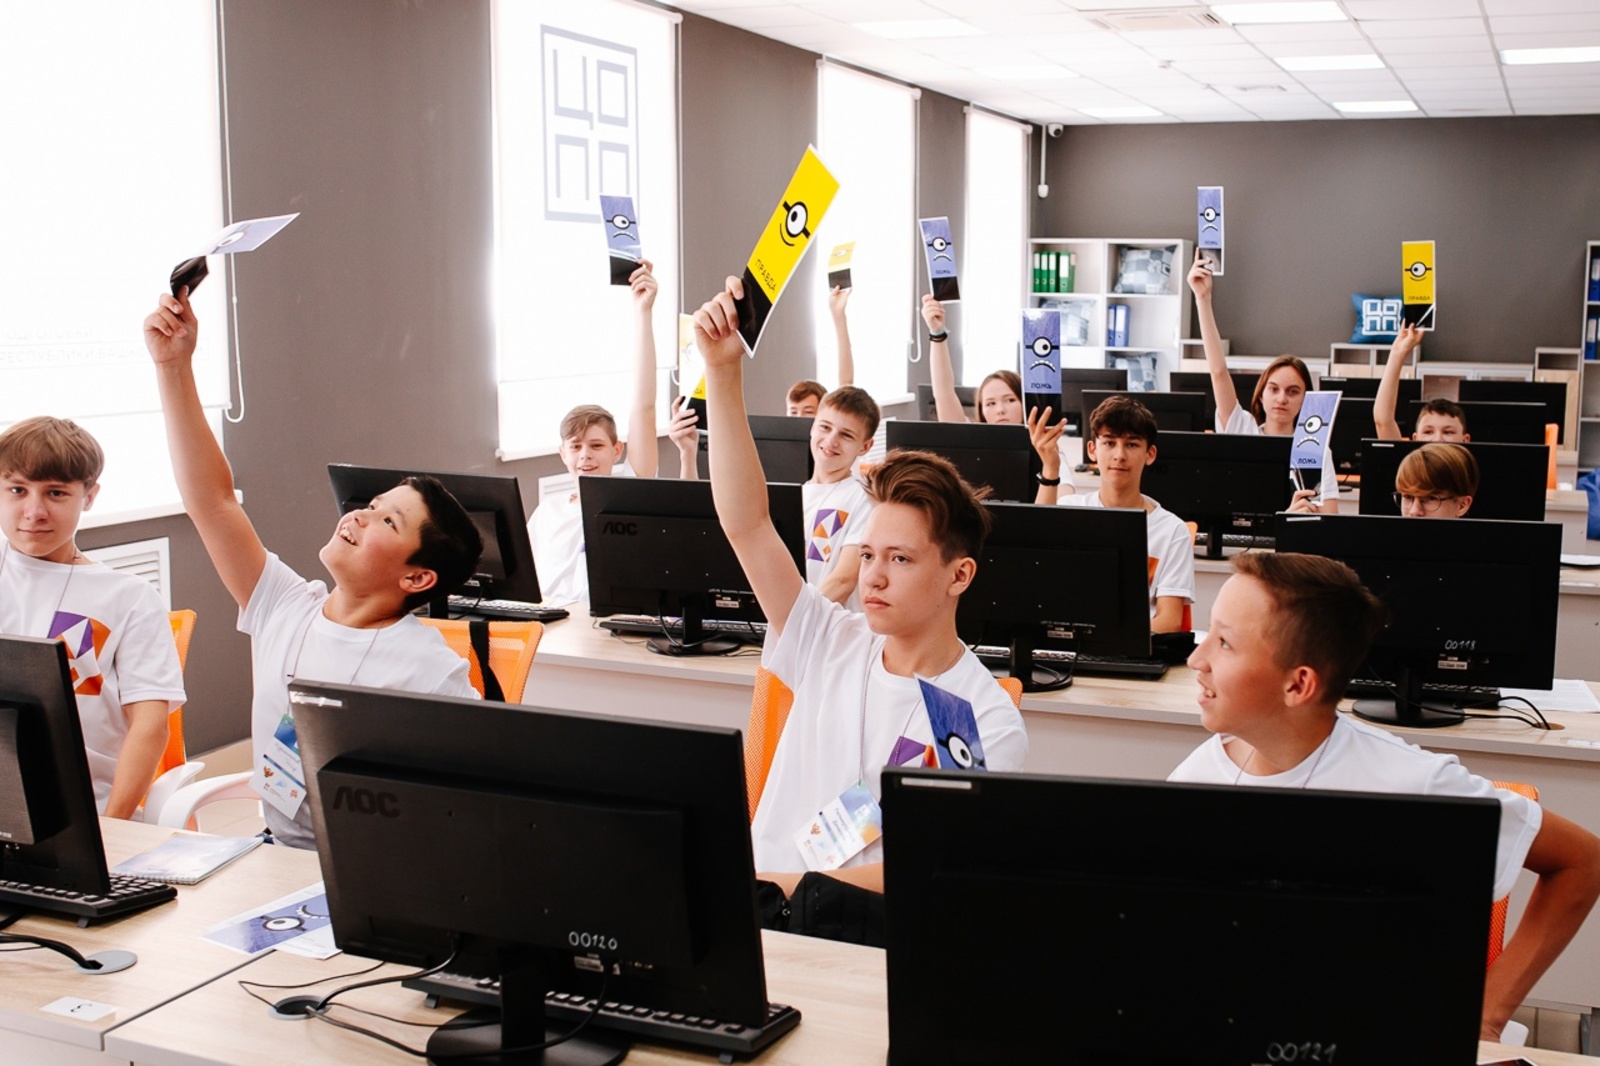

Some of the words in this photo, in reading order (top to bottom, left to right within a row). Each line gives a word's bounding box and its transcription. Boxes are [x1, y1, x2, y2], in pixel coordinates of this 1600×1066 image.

[756, 259, 777, 292] ПРАВДА
[1030, 382, 1053, 390] ЛОЖЬ
[1297, 457, 1318, 465] ЛОЖЬ
[602, 521, 639, 537] AOC
[1444, 639, 1477, 651] 00118
[332, 785, 402, 819] AOC
[568, 930, 619, 951] 00120
[1266, 1041, 1338, 1064] 00121
